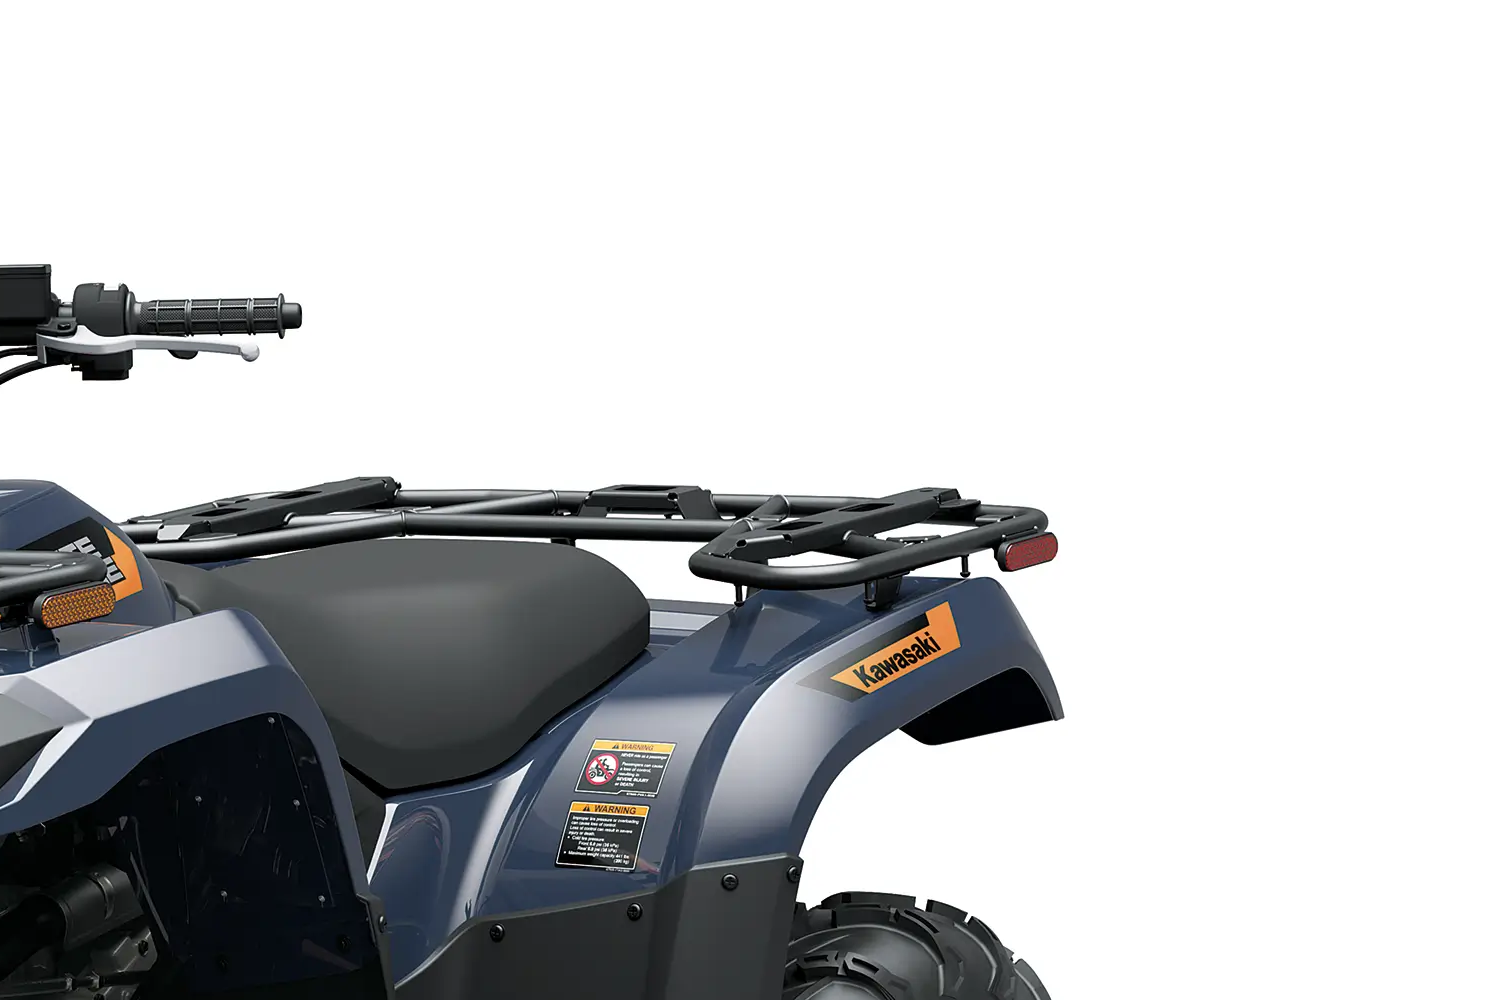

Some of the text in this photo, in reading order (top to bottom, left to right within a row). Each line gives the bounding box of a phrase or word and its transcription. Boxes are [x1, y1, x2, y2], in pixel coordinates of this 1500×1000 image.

[852, 631, 942, 688] Kawasaki
[621, 743, 655, 751] WARNING
[595, 804, 637, 815] WARNING
